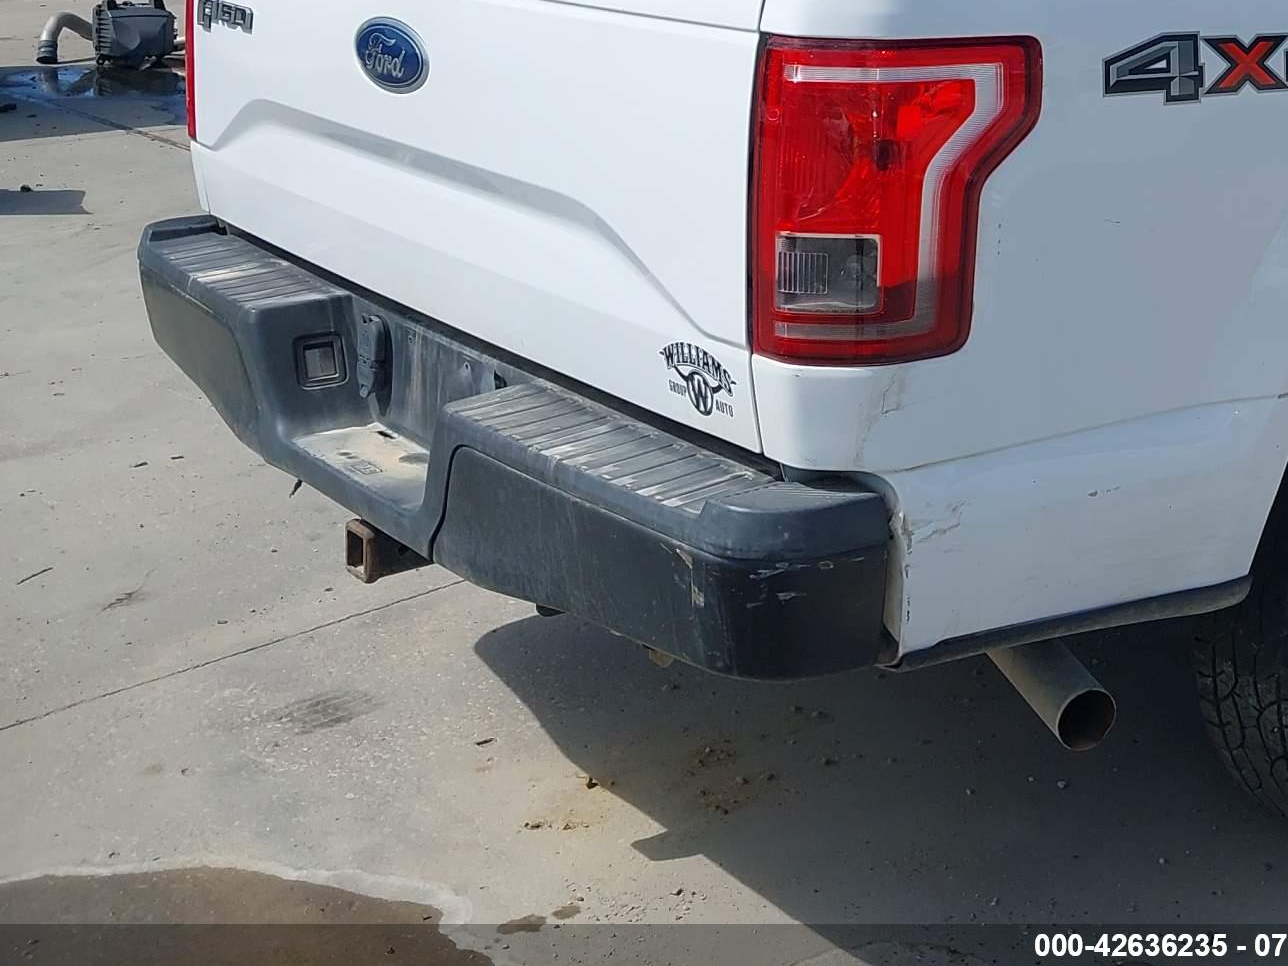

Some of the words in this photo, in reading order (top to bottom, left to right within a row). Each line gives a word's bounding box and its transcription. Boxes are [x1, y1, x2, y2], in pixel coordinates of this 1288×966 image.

[365, 32, 406, 78] Ford
[662, 341, 734, 398] WILLIAMS
[668, 379, 688, 397] GROUP
[715, 398, 734, 418] AUTO
